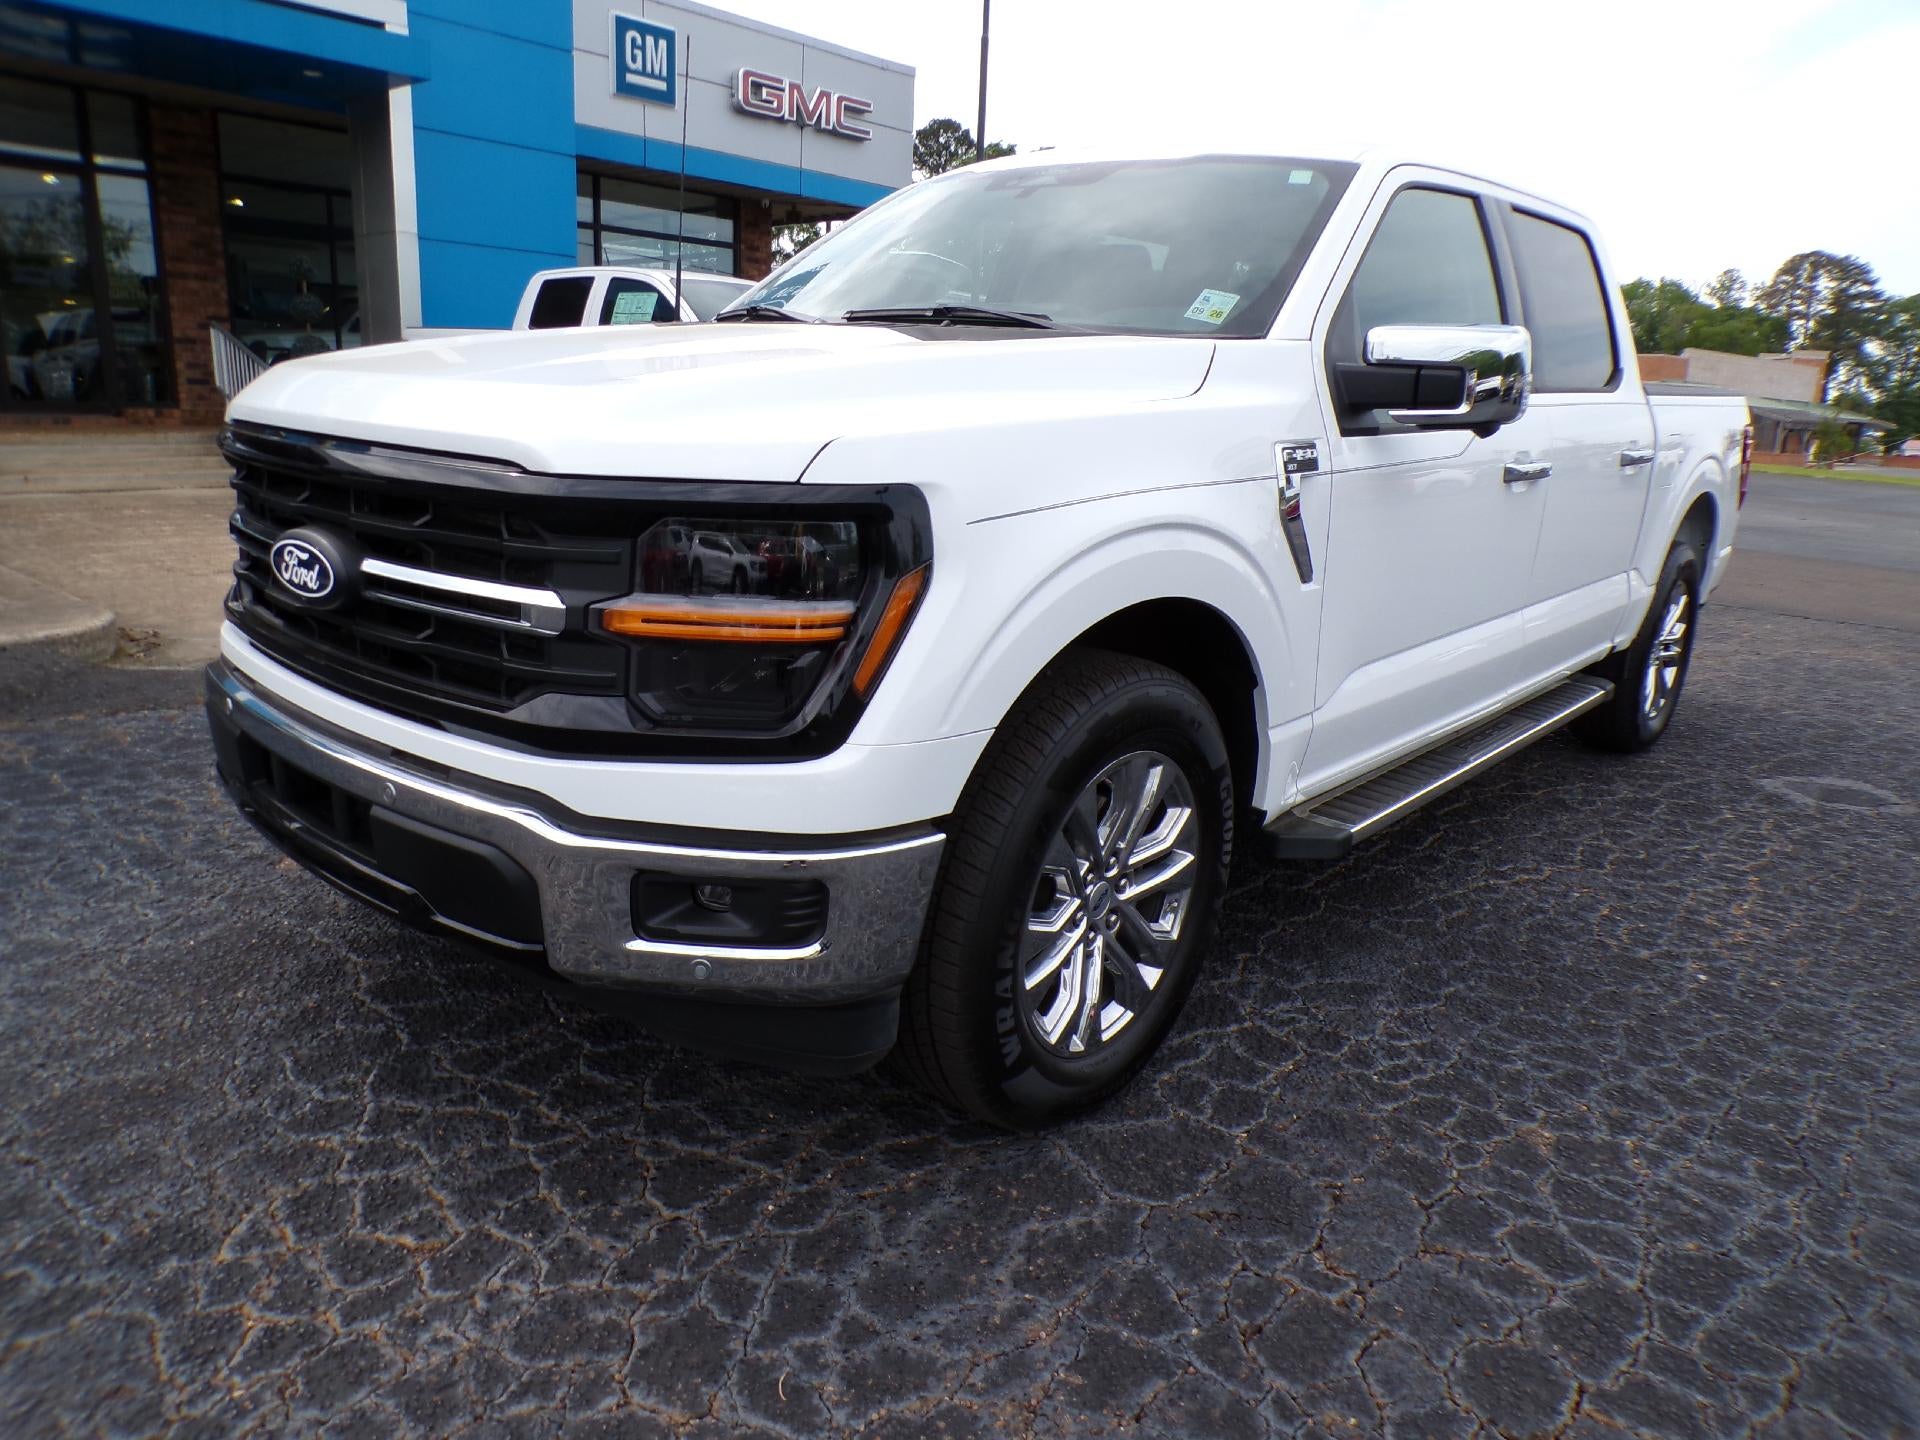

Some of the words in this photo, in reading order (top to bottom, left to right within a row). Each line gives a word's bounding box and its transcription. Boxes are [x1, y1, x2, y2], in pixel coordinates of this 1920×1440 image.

[625, 30, 668, 78] GM
[738, 67, 873, 141] GMC
[1283, 448, 1317, 461] F-150
[281, 545, 320, 590] Ford
